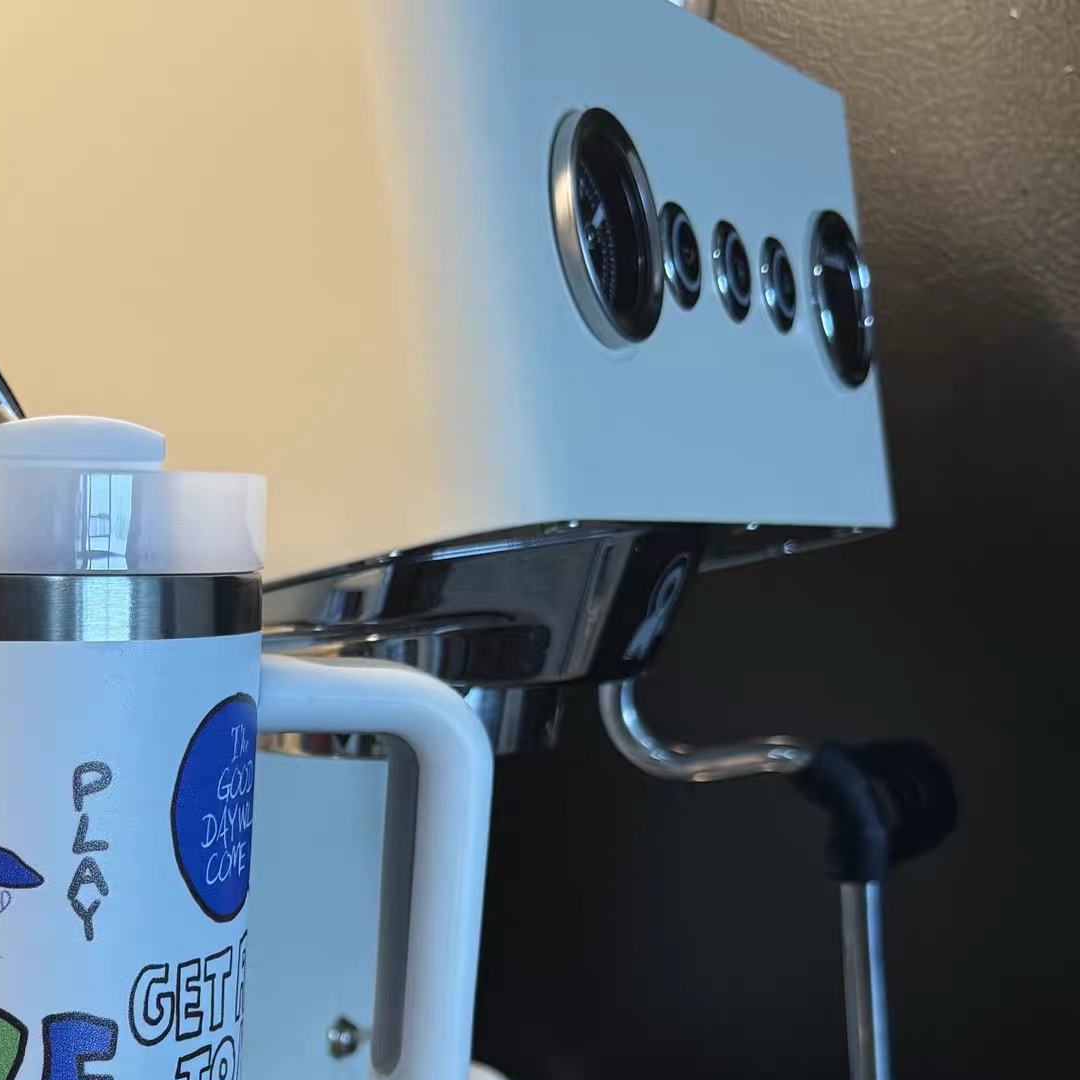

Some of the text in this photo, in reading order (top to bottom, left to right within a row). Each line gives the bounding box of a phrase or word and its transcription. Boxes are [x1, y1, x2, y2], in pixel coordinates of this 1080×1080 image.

[217, 759, 254, 803] GOOD
[201, 803, 238, 849] DAY
[66, 761, 112, 942] PLAY
[206, 841, 247, 886] COME
[129, 946, 233, 1047] GET
